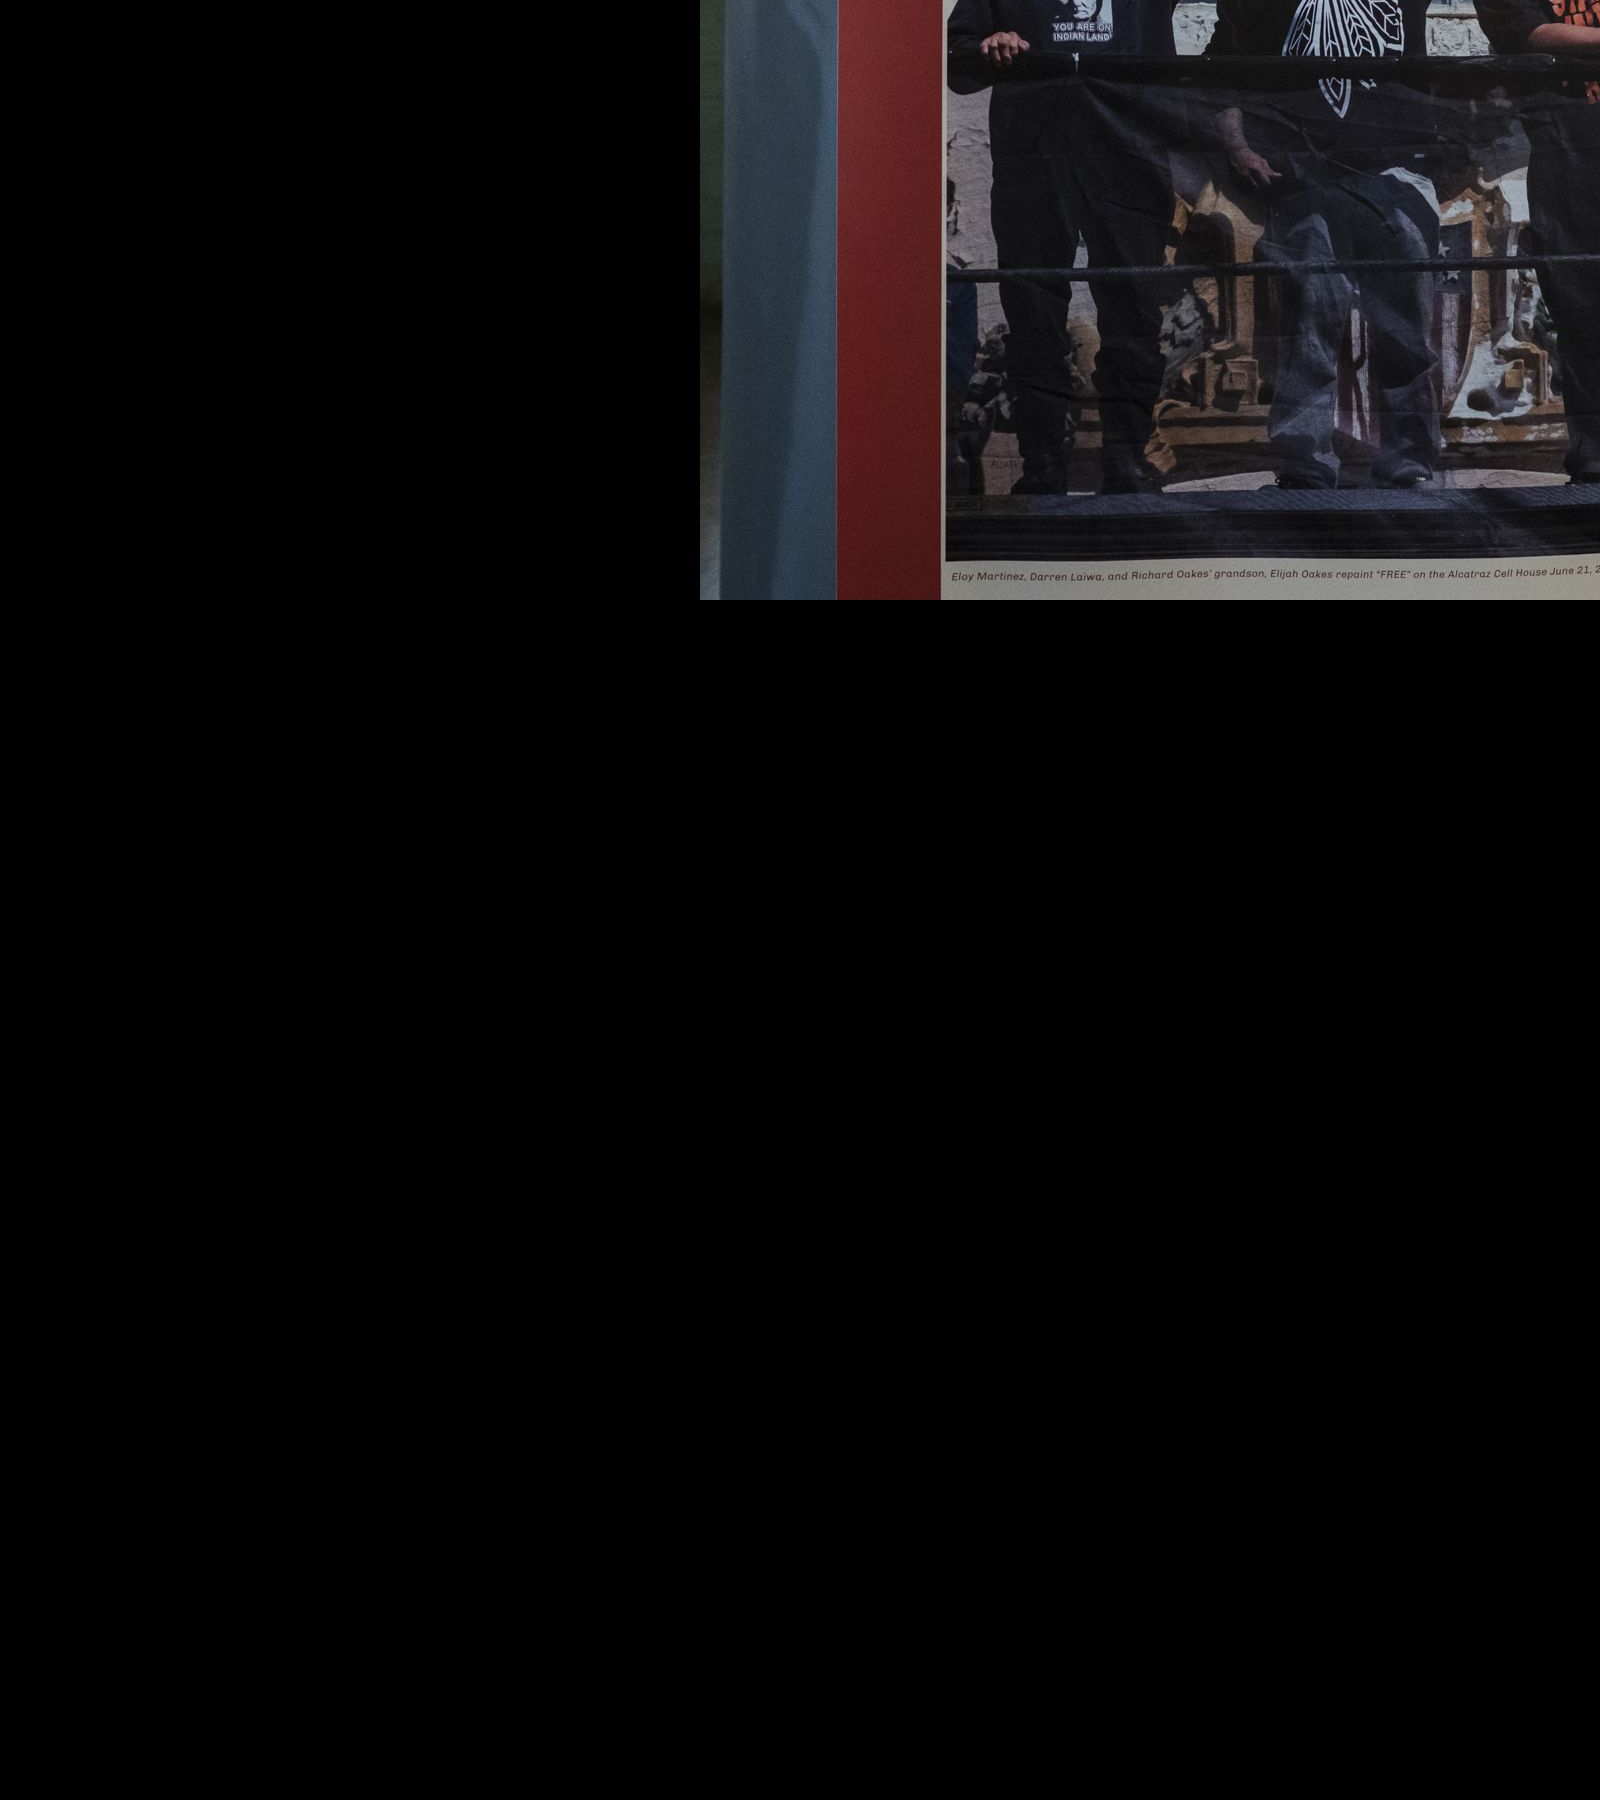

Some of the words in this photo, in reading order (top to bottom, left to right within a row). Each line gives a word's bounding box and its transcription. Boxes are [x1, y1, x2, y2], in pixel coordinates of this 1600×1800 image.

[1052, 23, 1074, 31] YOU
[1076, 23, 1095, 31] ARE
[1098, 23, 1111, 31] ON
[1053, 32, 1085, 41] INDIAN
[1086, 33, 1111, 41] LAND
[951, 572, 974, 583] Eloy
[977, 572, 1027, 582] Martinez,
[1030, 572, 1068, 582] Darren
[1070, 572, 1105, 583] Laiwa,
[1108, 572, 1128, 581] and
[1131, 570, 1174, 580] Richard
[1176, 569, 1212, 579] Oakes'
[1214, 569, 1268, 580] grandson,
[1270, 569, 1299, 580] Elijah
[1301, 569, 1333, 579] Oakes
[1336, 569, 1373, 580] repaint
[1377, 570, 1411, 579] "FREE"
[1429, 570, 1445, 579] the
[1447, 570, 1491, 579] Alcatraz
[1494, 569, 1513, 579] Cell
[1515, 568, 1547, 577] House
[1550, 566, 1574, 576] June
[1577, 565, 1593, 575] 21,
